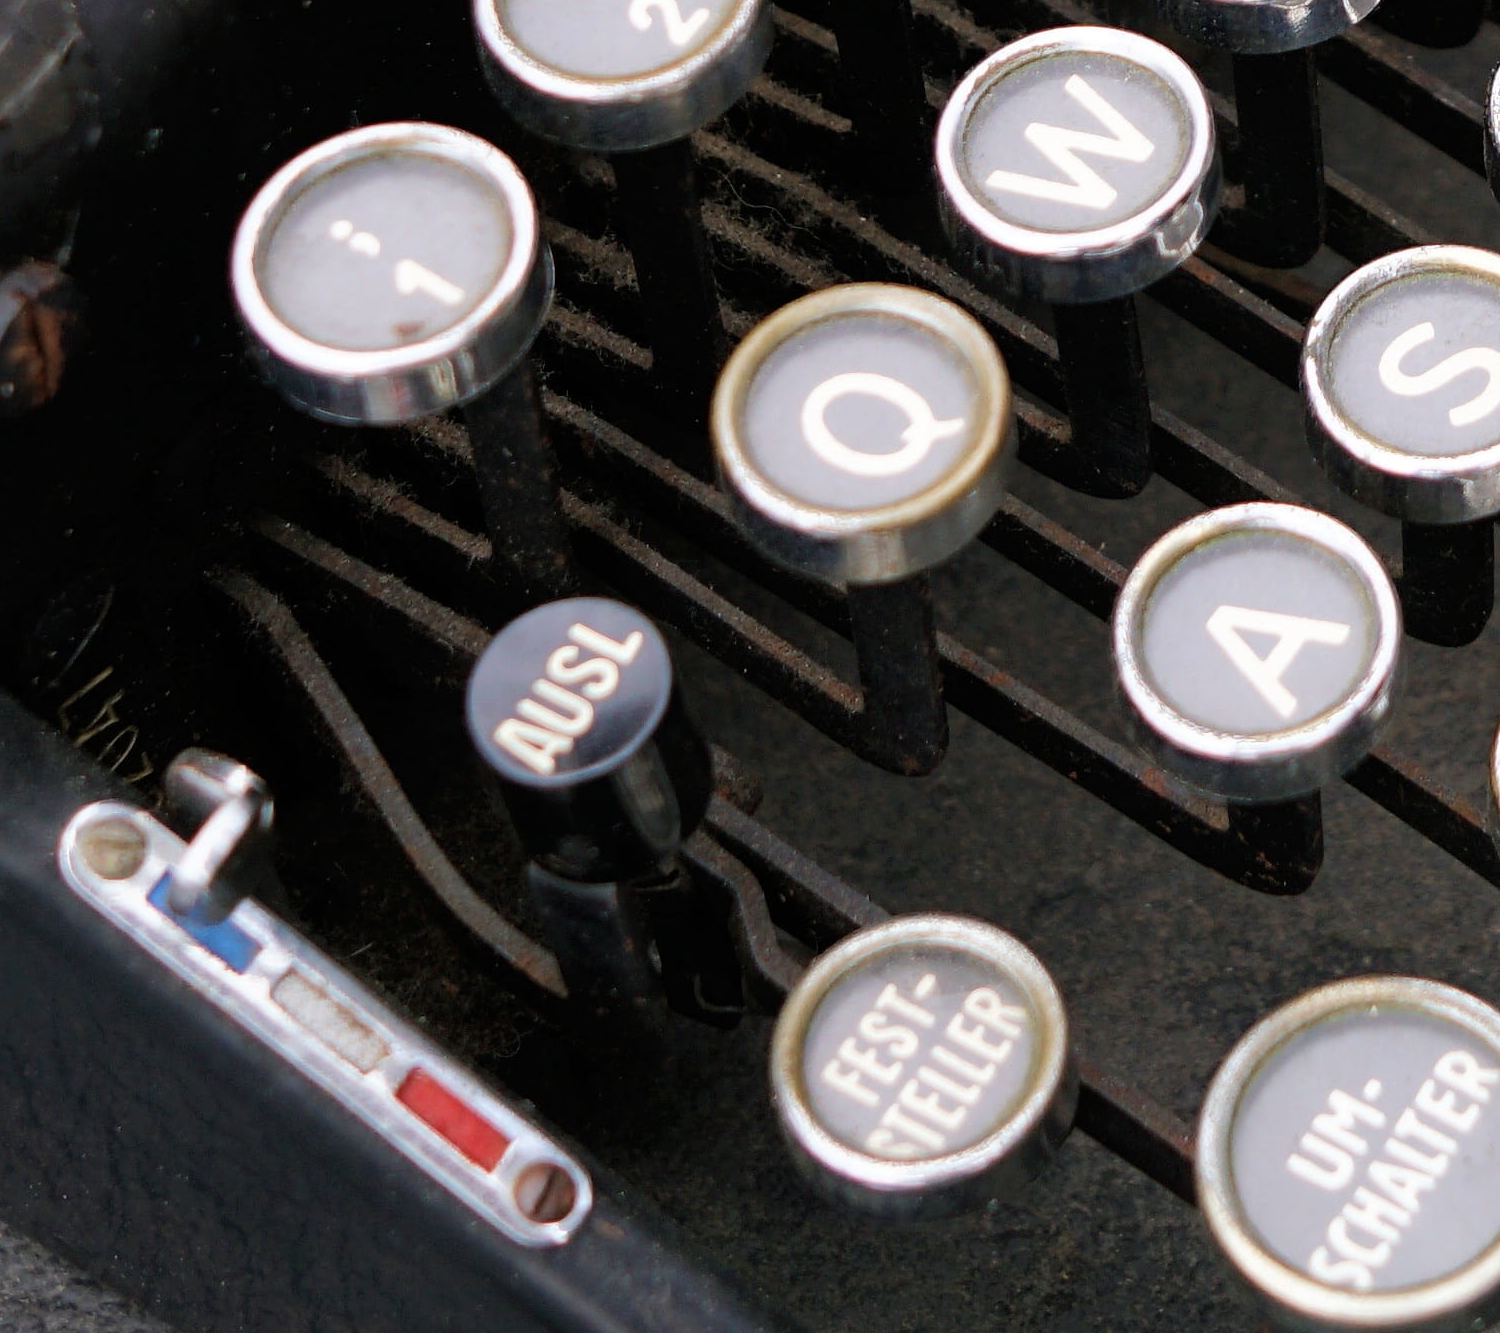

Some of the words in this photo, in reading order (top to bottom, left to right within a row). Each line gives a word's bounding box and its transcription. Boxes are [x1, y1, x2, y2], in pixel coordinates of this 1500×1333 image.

[986, 75, 1157, 211] W
[395, 260, 463, 303] 1
[801, 373, 964, 476] Q
[493, 619, 645, 781] AUSL
[1206, 606, 1353, 720] A
[821, 971, 943, 1109] FEST-
[864, 987, 1031, 1163] STELLER
[1286, 1076, 1387, 1192] UM-
